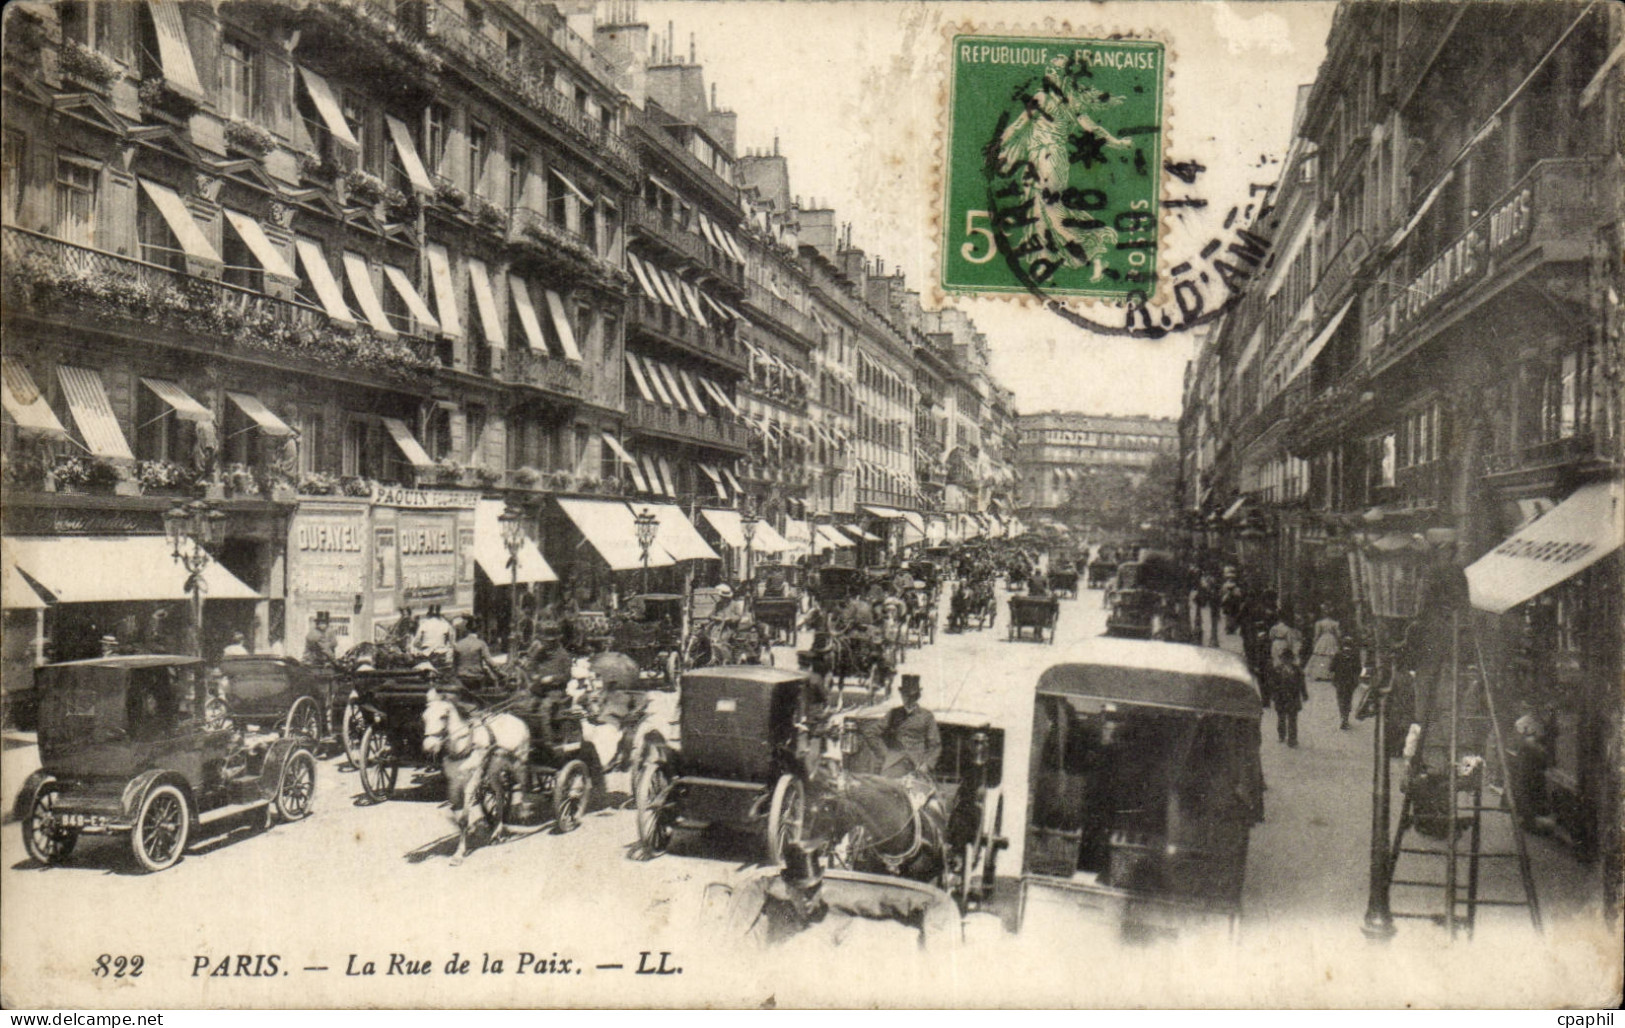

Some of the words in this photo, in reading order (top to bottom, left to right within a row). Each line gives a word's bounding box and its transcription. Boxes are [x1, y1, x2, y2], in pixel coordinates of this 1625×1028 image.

[1074, 48, 1155, 70] FRANÇAISE
[376, 488, 429, 505] PAQUIN
[300, 524, 361, 553] DUFAYEL
[402, 530, 454, 555] DUFAYEL
